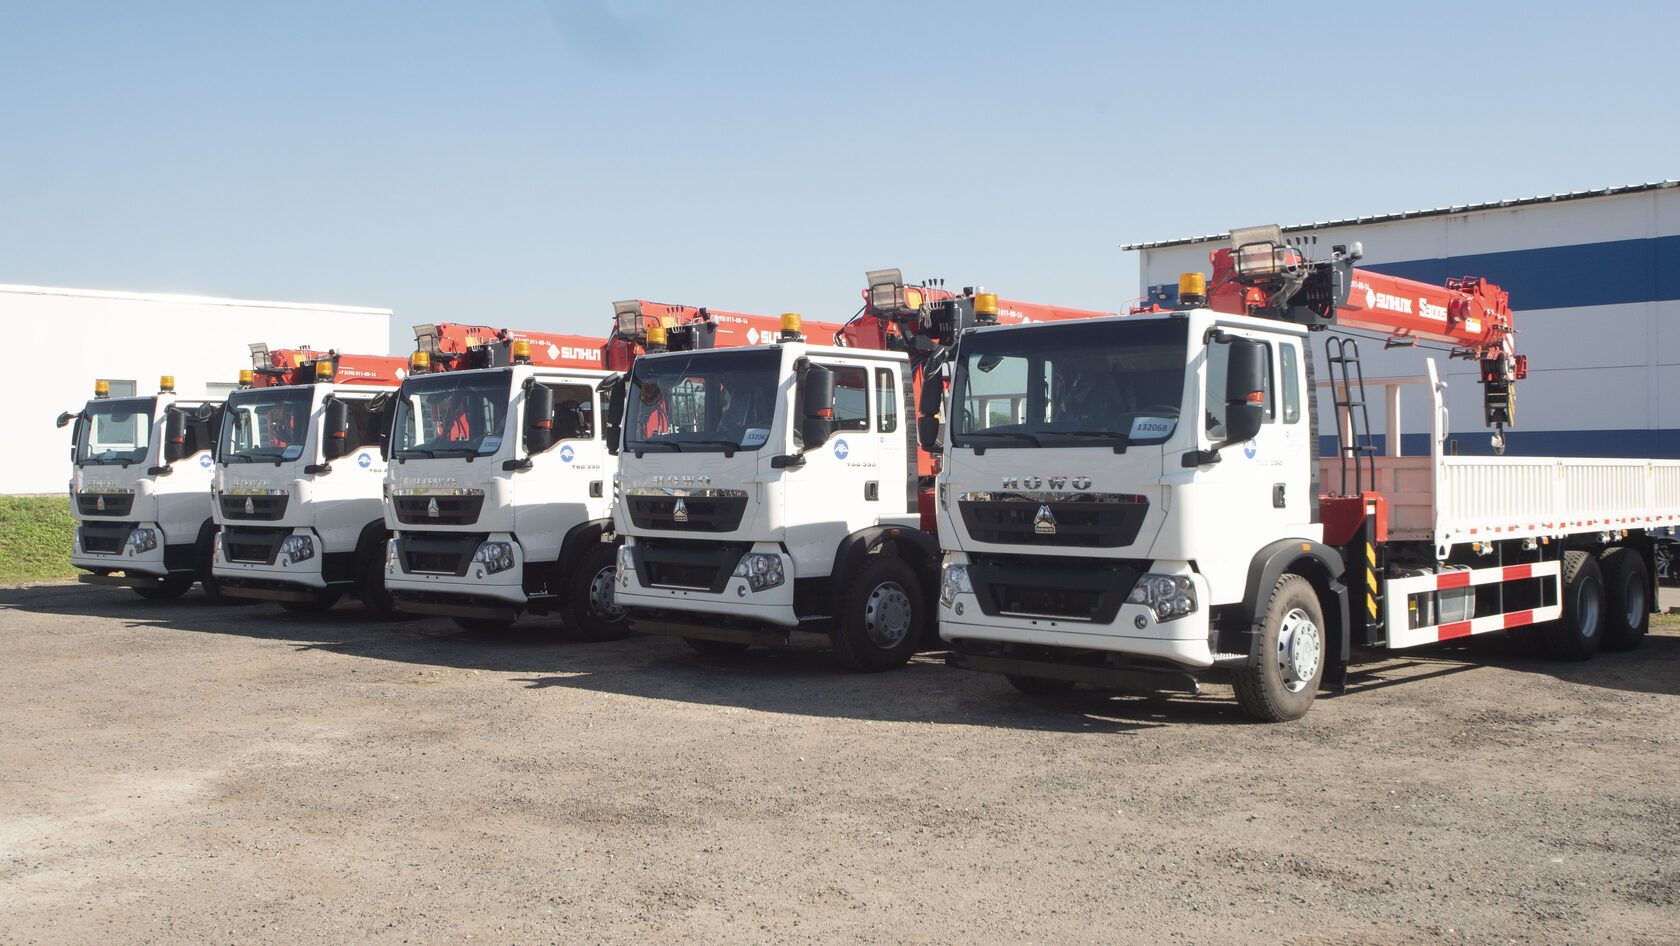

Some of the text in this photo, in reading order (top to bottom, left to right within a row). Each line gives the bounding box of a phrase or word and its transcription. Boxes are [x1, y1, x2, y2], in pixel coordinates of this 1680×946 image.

[1376, 292, 1413, 314] SUNHUNK
[561, 346, 601, 361] SUNHUN
[1137, 423, 1169, 432] 132068
[653, 474, 712, 487] HOWO
[1002, 475, 1092, 490] HOWO
